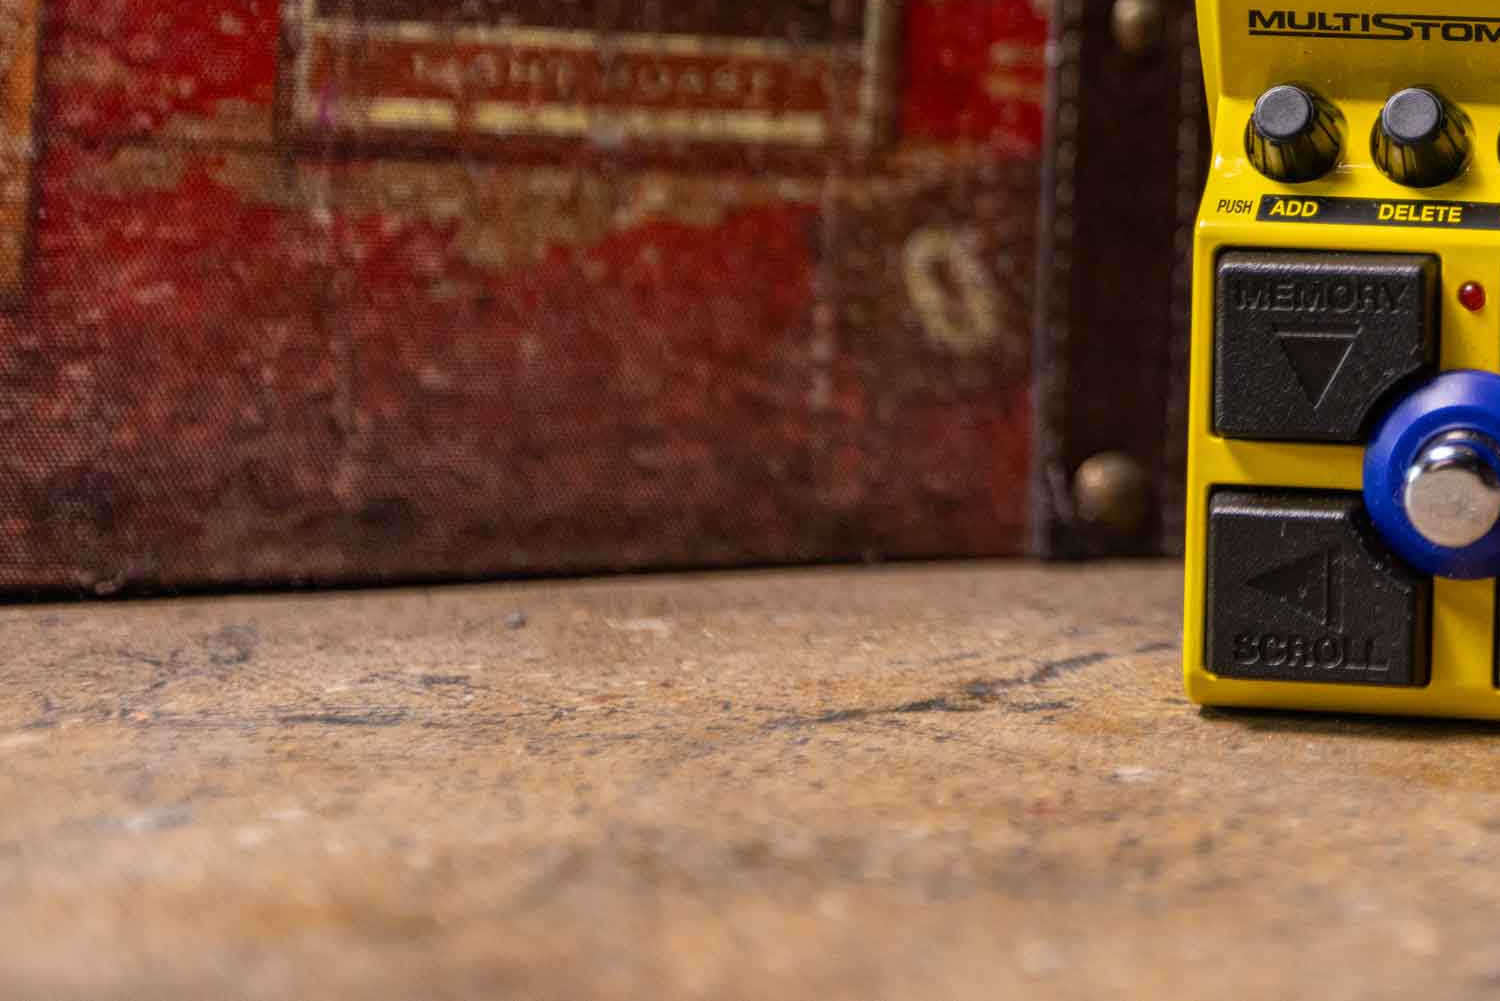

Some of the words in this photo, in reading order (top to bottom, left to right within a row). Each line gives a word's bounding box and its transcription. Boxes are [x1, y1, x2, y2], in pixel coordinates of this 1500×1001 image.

[1216, 199, 1253, 214] PUSH
[1269, 200, 1318, 217] ADD
[1378, 205, 1462, 223] DELETE
[1234, 277, 1411, 313] MEMORY
[1232, 631, 1389, 672] SCROLL
